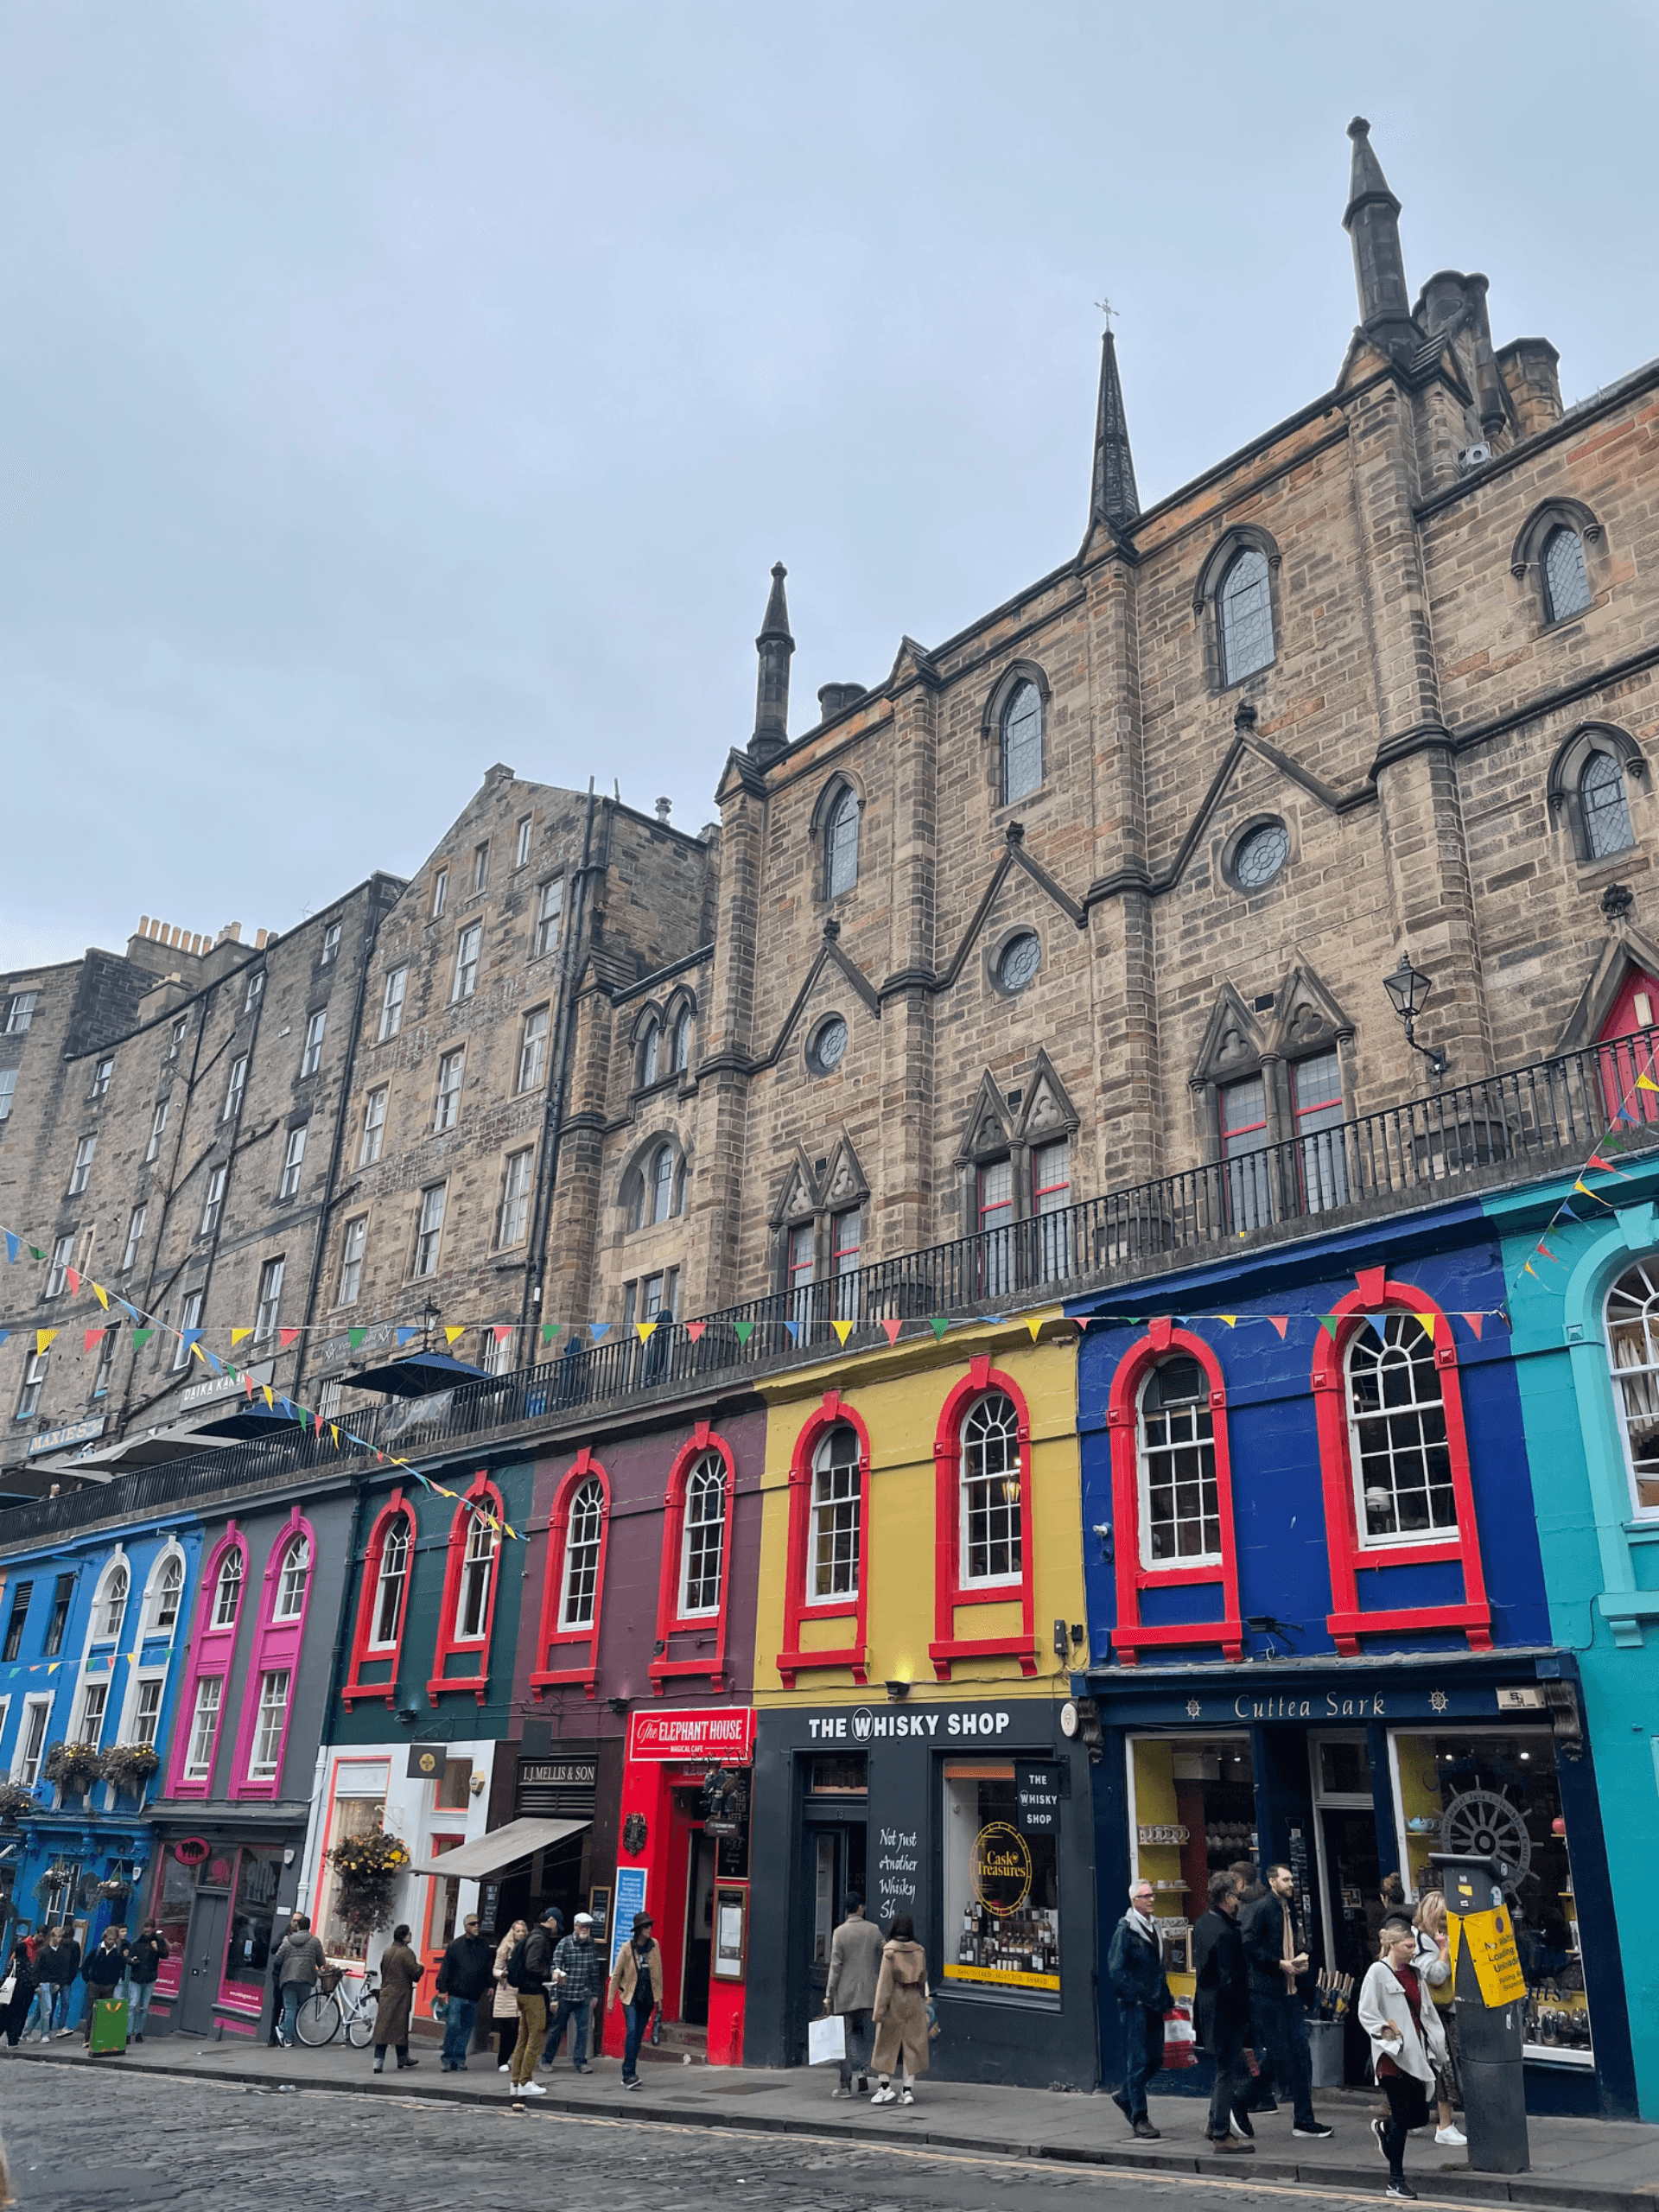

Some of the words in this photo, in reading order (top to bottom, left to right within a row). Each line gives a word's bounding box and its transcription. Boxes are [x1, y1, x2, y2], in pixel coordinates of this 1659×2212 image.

[184, 1382, 213, 1401] DAIKA
[32, 1423, 88, 1450] MAXIES
[1235, 1694, 1311, 1718] Cuttea
[1326, 1691, 1385, 1716] Sark
[638, 1719, 662, 1744] The
[658, 1721, 709, 1741] ELEPHANT
[709, 1719, 742, 1740] HOUSE
[809, 1718, 847, 1738] THE
[854, 1714, 939, 1738] WHISKY
[947, 1712, 1009, 1735] SHOP
[536, 1766, 566, 1781] MELLIS
[567, 1766, 574, 1781] &
[575, 1765, 595, 1780] SON
[1028, 1774, 1047, 1785] THE
[1020, 1794, 1058, 1806] WHISKY
[1027, 1814, 1052, 1825] SHOP
[880, 1827, 896, 1846] Not
[895, 1832, 917, 1853] Just
[879, 1854, 918, 1872] Another
[987, 1851, 1014, 1866] Cask
[977, 1861, 1027, 1878] Treasures
[879, 1876, 916, 1904] Whisky
